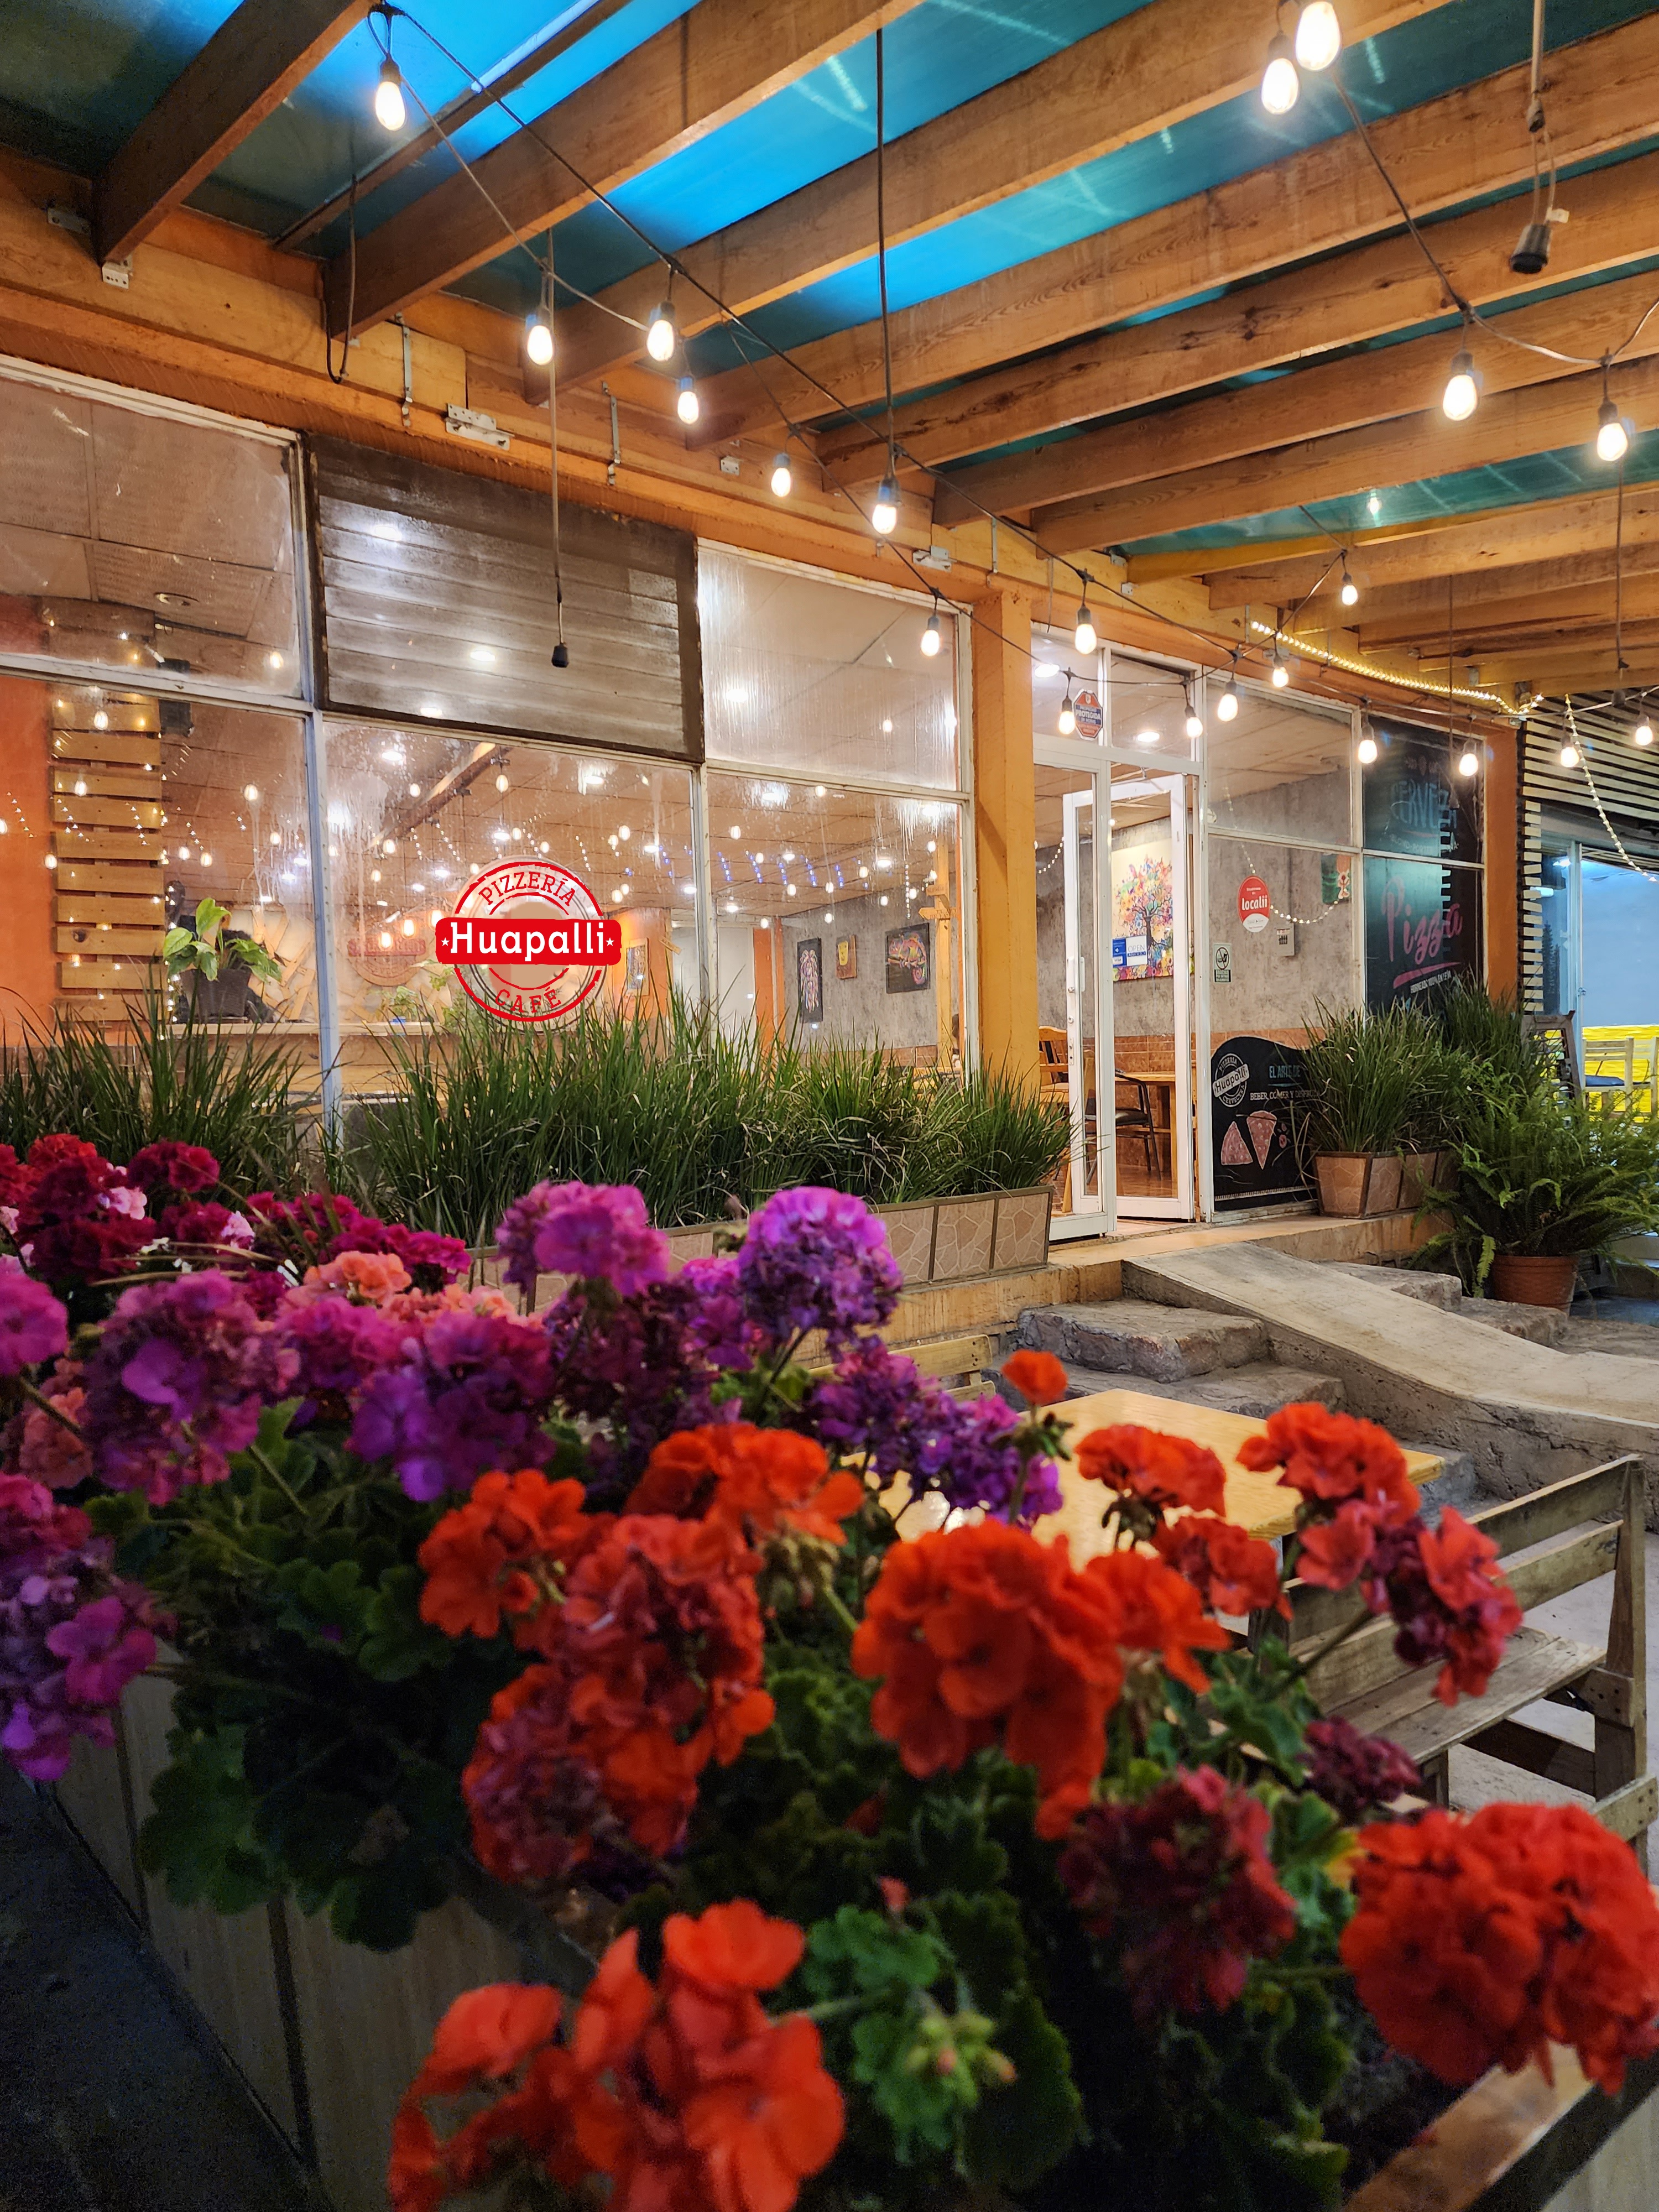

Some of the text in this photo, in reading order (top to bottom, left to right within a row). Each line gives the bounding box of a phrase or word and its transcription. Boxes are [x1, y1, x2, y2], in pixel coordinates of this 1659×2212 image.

[478, 872, 576, 907] PIZZERÍA
[1381, 876, 1463, 965] Pizza
[450, 922, 604, 962] Huapalli
[495, 987, 561, 1013] CAFÉ
[1215, 1066, 1246, 1093] Huapalli
[1269, 1066, 1276, 1078] EL
